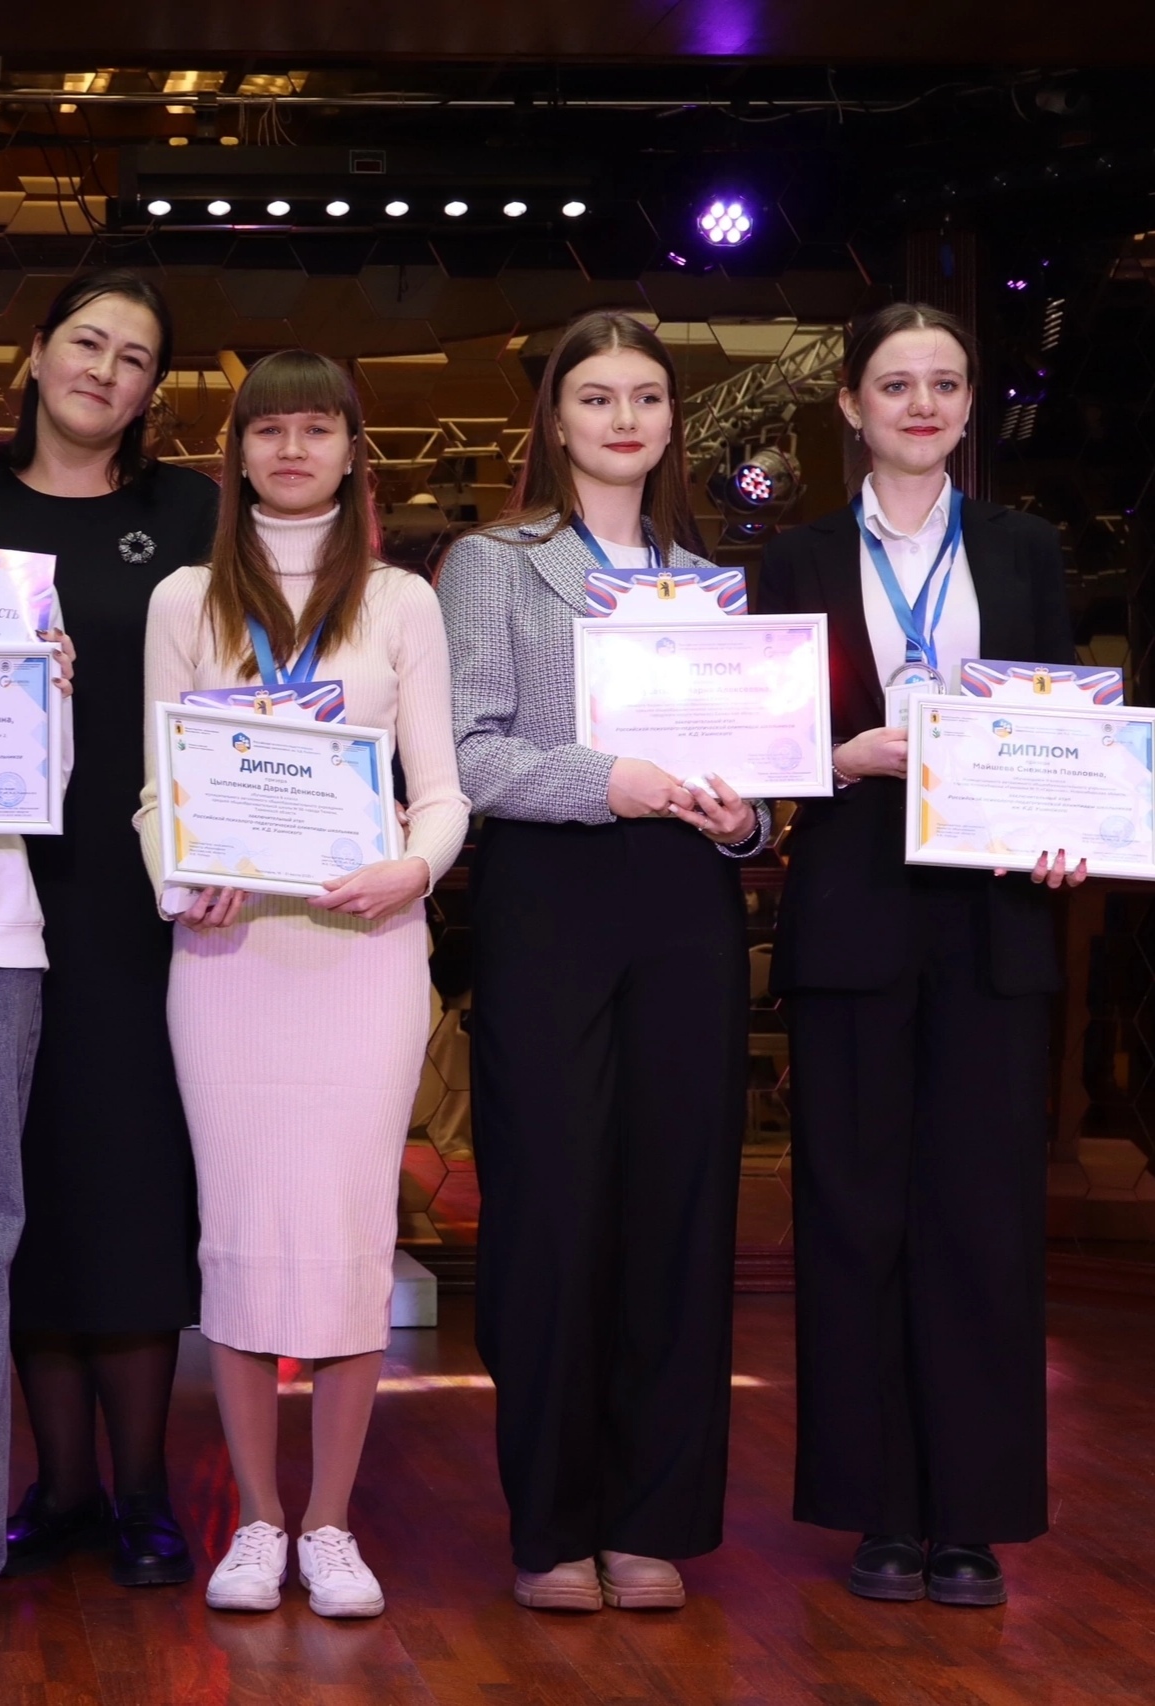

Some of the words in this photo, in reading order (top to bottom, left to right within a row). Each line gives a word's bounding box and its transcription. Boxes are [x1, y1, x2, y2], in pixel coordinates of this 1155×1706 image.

[998, 743, 1079, 759] ДИПЛОМ
[240, 758, 312, 778] ДИПЛОМ
[1017, 765, 1058, 775] Снежана
[1060, 769, 1107, 779] Павловна,
[209, 778, 262, 790] Цыпленкина
[263, 784, 289, 793] Дарья
[290, 787, 337, 799] Денисовна,
